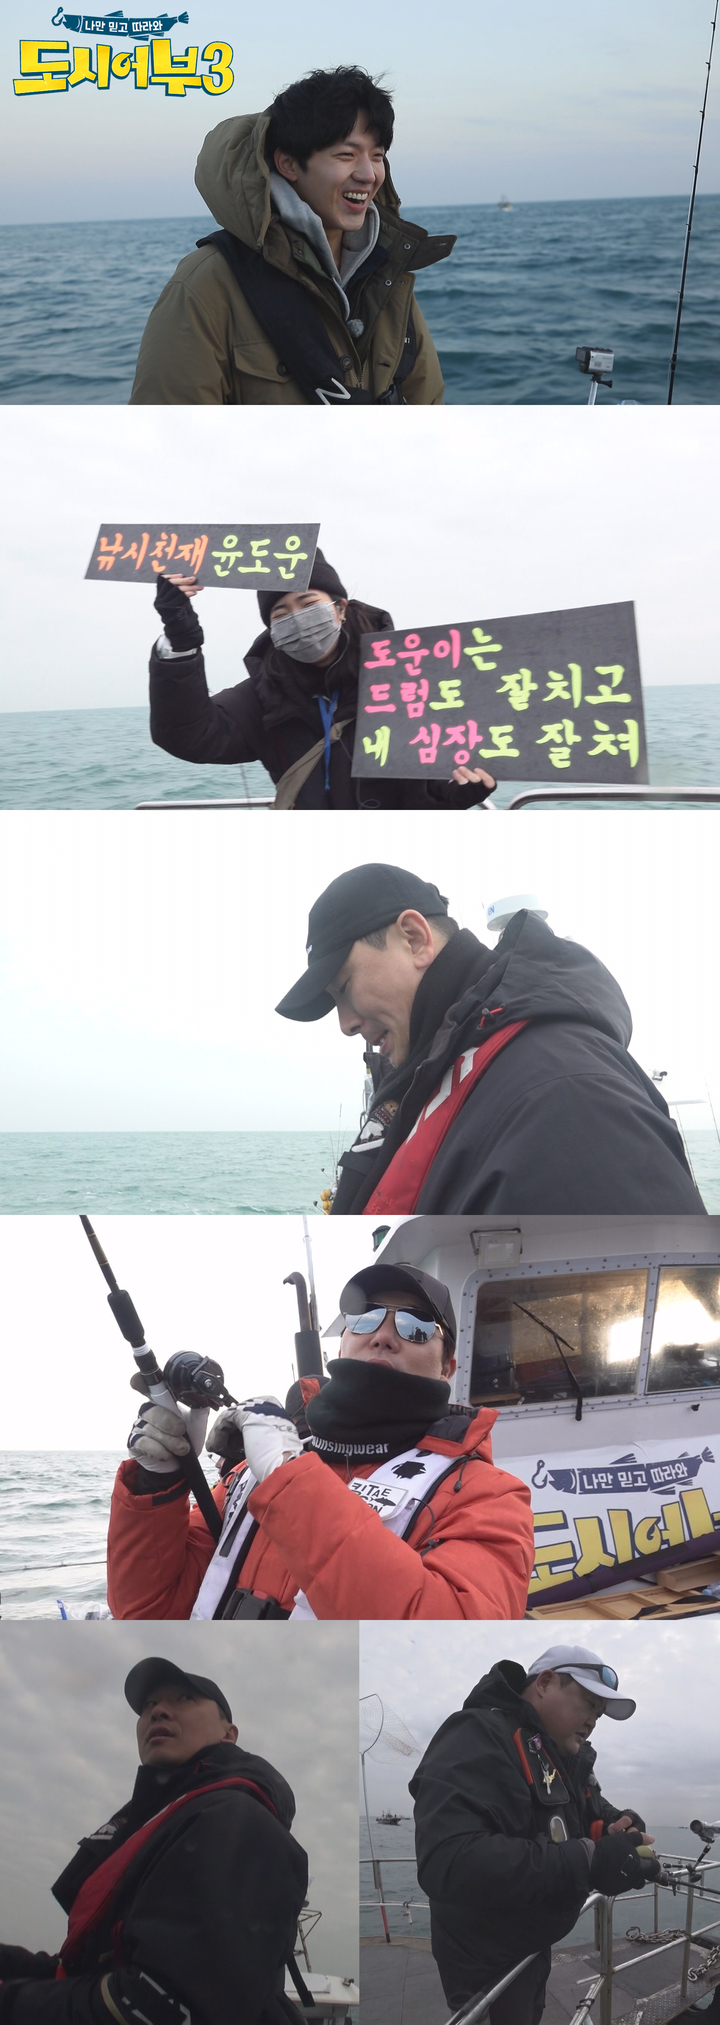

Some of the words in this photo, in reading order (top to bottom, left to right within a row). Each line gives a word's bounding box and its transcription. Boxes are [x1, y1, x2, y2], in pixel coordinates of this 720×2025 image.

[96, 531, 209, 575] 낚시천재
[211, 534, 308, 580] 윤도운
[363, 627, 503, 676] 도운이는
[364, 678, 465, 719] 드럼도
[362, 725, 391, 767] 내
[409, 720, 520, 765] 심장도
[582, 1472, 613, 1490] 나만
[618, 1470, 648, 1488] 믿고
[651, 1462, 688, 1483] 따라와
